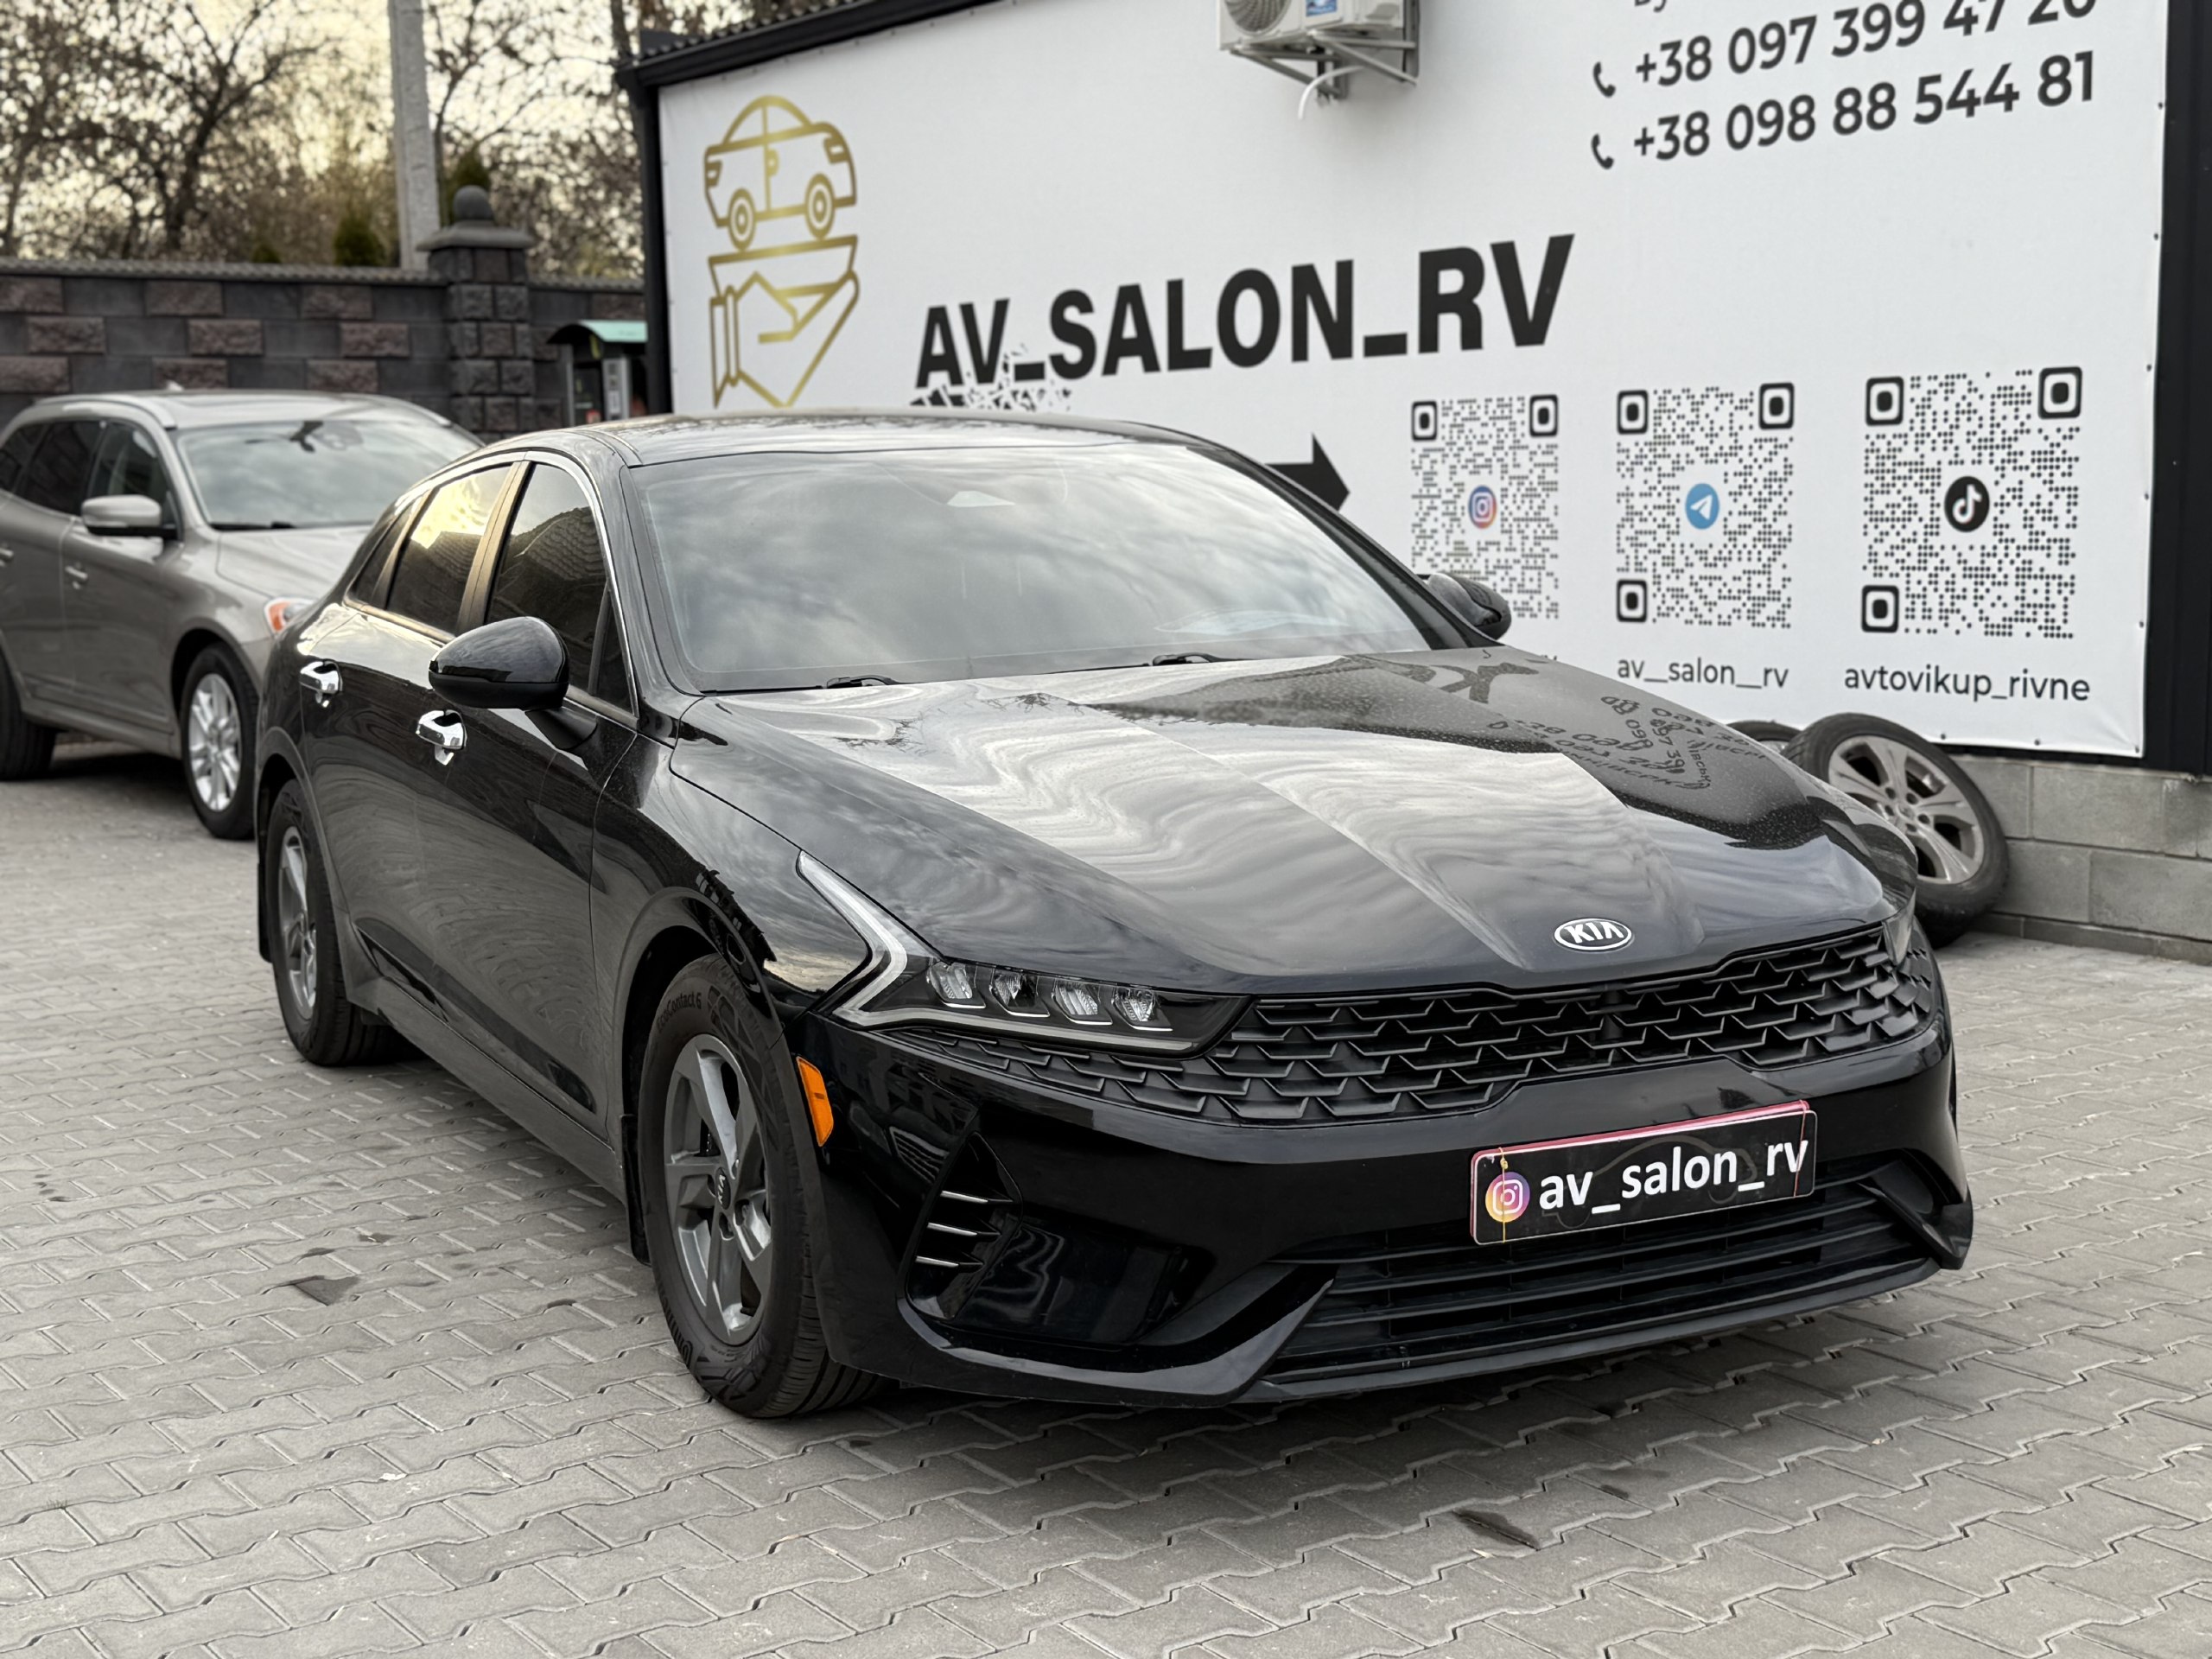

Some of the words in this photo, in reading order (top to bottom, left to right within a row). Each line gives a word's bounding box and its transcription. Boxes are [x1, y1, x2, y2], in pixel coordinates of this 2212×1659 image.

[1635, 35, 1712, 86] +38
[1728, 15, 1817, 74] 097
[1832, 0, 1925, 57] 399
[1634, 111, 1710, 161] +38
[1726, 94, 1815, 150] 098
[1833, 82, 1897, 136] 88
[1914, 63, 2020, 124] 544
[2037, 50, 2093, 107] 81
[916, 234, 1574, 388] AV_SALON_RV
[1844, 664, 2090, 702] avtovikup_rivne
[1564, 921, 1624, 944] KIA
[1539, 1140, 1808, 1214] av_salon_rv
